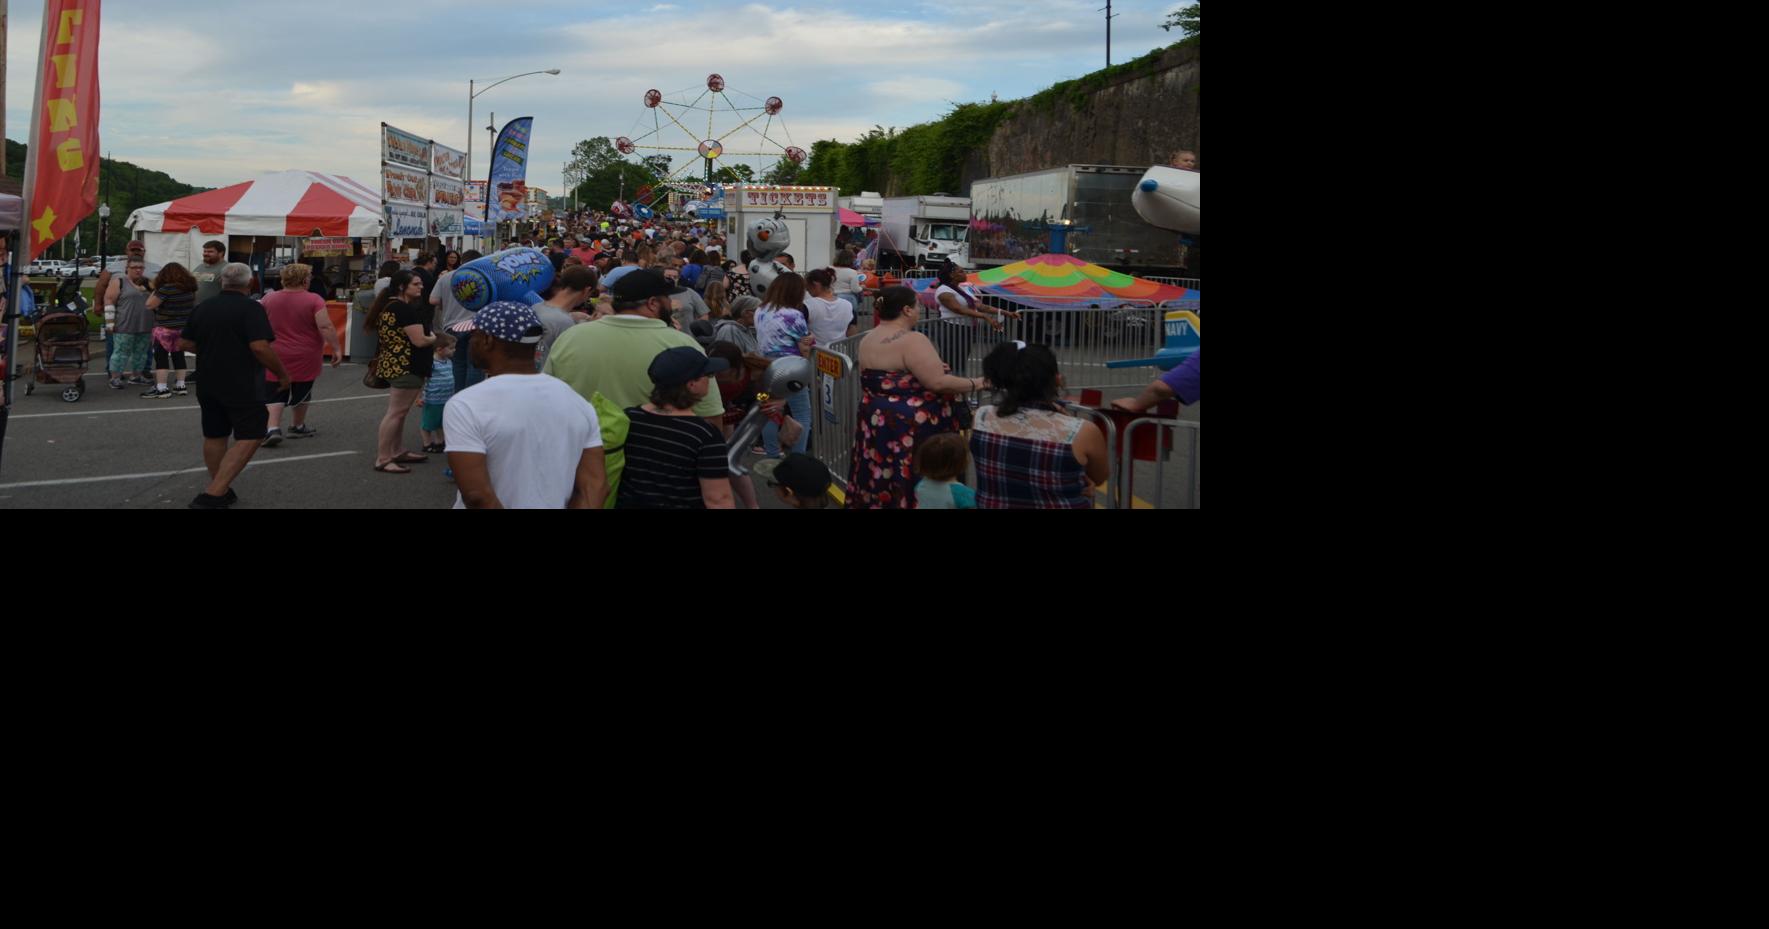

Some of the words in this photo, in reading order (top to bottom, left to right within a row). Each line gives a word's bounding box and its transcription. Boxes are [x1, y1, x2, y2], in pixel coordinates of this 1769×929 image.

[747, 192, 828, 206] TICKETS
[496, 252, 540, 274] POW!
[1165, 322, 1188, 336] NAVY
[817, 353, 840, 375] ENTER
[825, 384, 832, 405] 3
